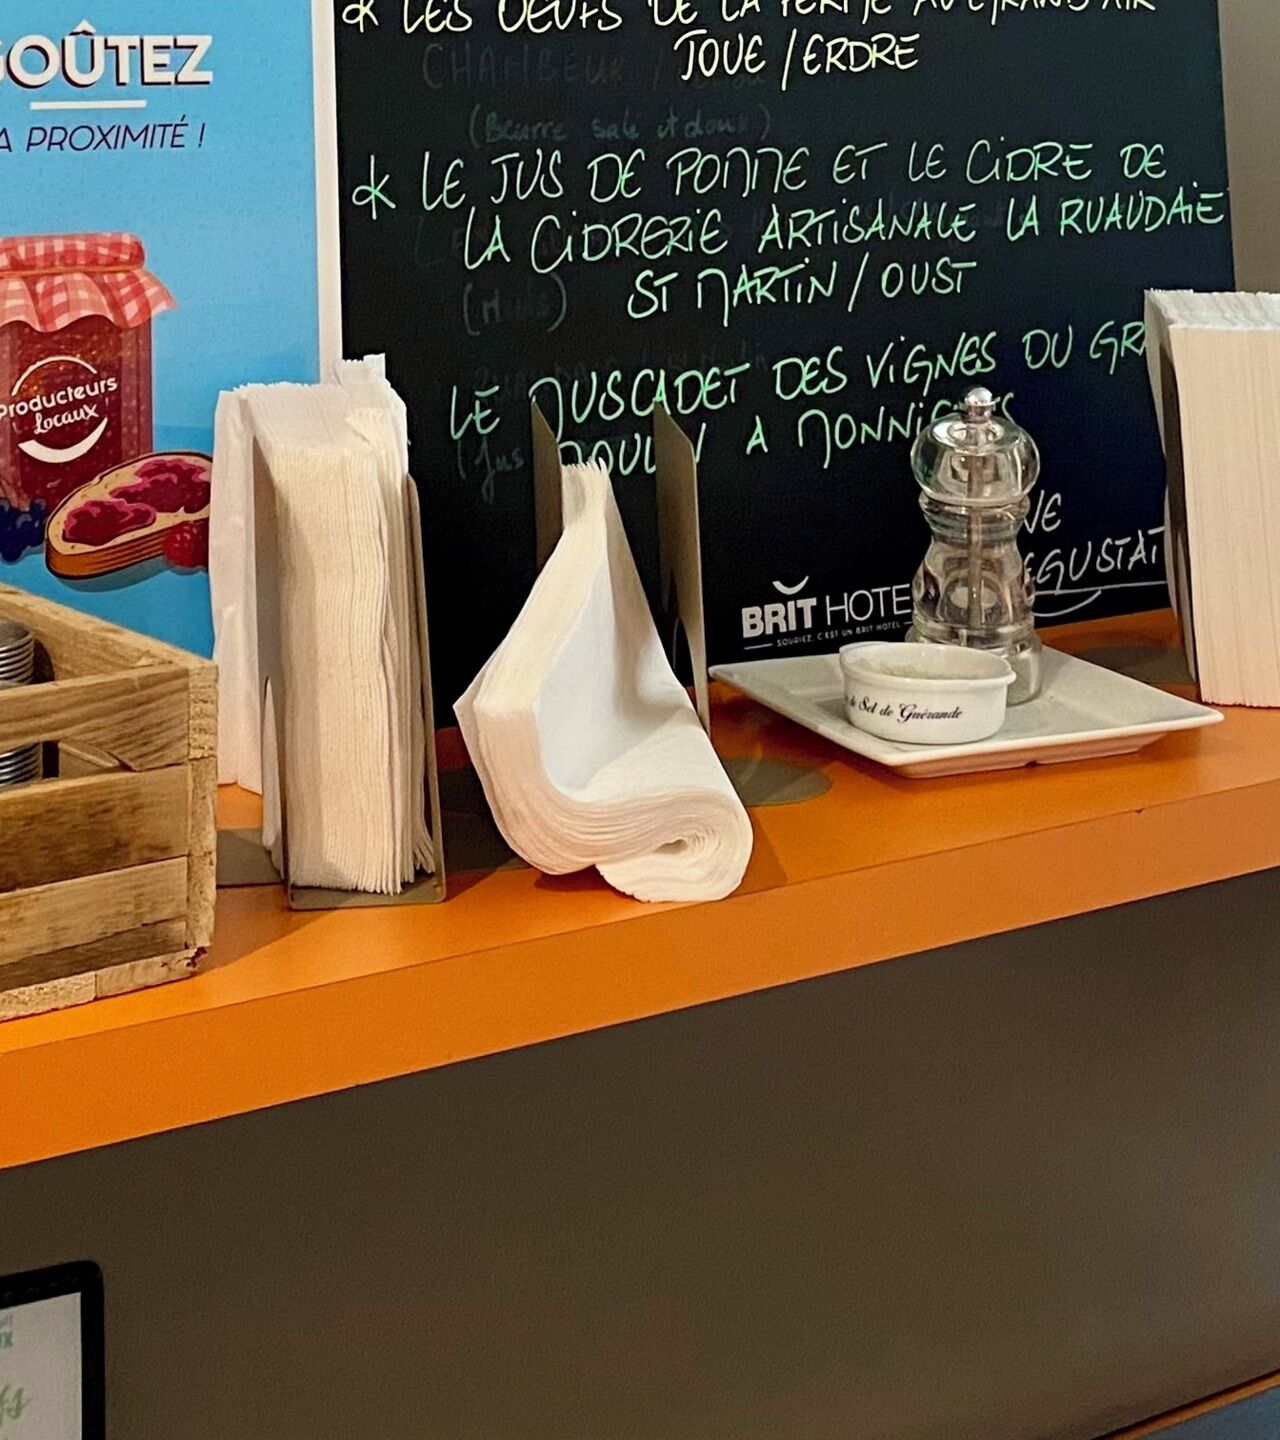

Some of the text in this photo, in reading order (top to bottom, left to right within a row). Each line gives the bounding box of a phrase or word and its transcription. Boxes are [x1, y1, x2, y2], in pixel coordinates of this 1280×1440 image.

[674, 29, 765, 80] JOUE
[26, 114, 189, 152] PROXIMITÉ
[423, 152, 465, 210] LE
[491, 148, 563, 203] JUS
[587, 149, 645, 202] DE
[666, 147, 809, 197] POMME
[833, 143, 887, 183] ET
[909, 142, 946, 181] LE
[1120, 143, 1166, 178] DE
[465, 206, 510, 269] LA
[1007, 195, 1039, 241] LA
[628, 270, 678, 318] ST
[882, 257, 977, 297] OUST
[451, 386, 499, 439] LE
[529, 363, 750, 443] MUSCADET
[772, 347, 847, 400] DES
[1022, 326, 1072, 369] DU
[1089, 321, 1145, 375] GR
[33, 404, 100, 435] Locaux
[746, 416, 768, 454] A
[741, 583, 912, 639] BRIT HOTE
[858, 696, 877, 714] Sel
[896, 703, 963, 723] Guérande
